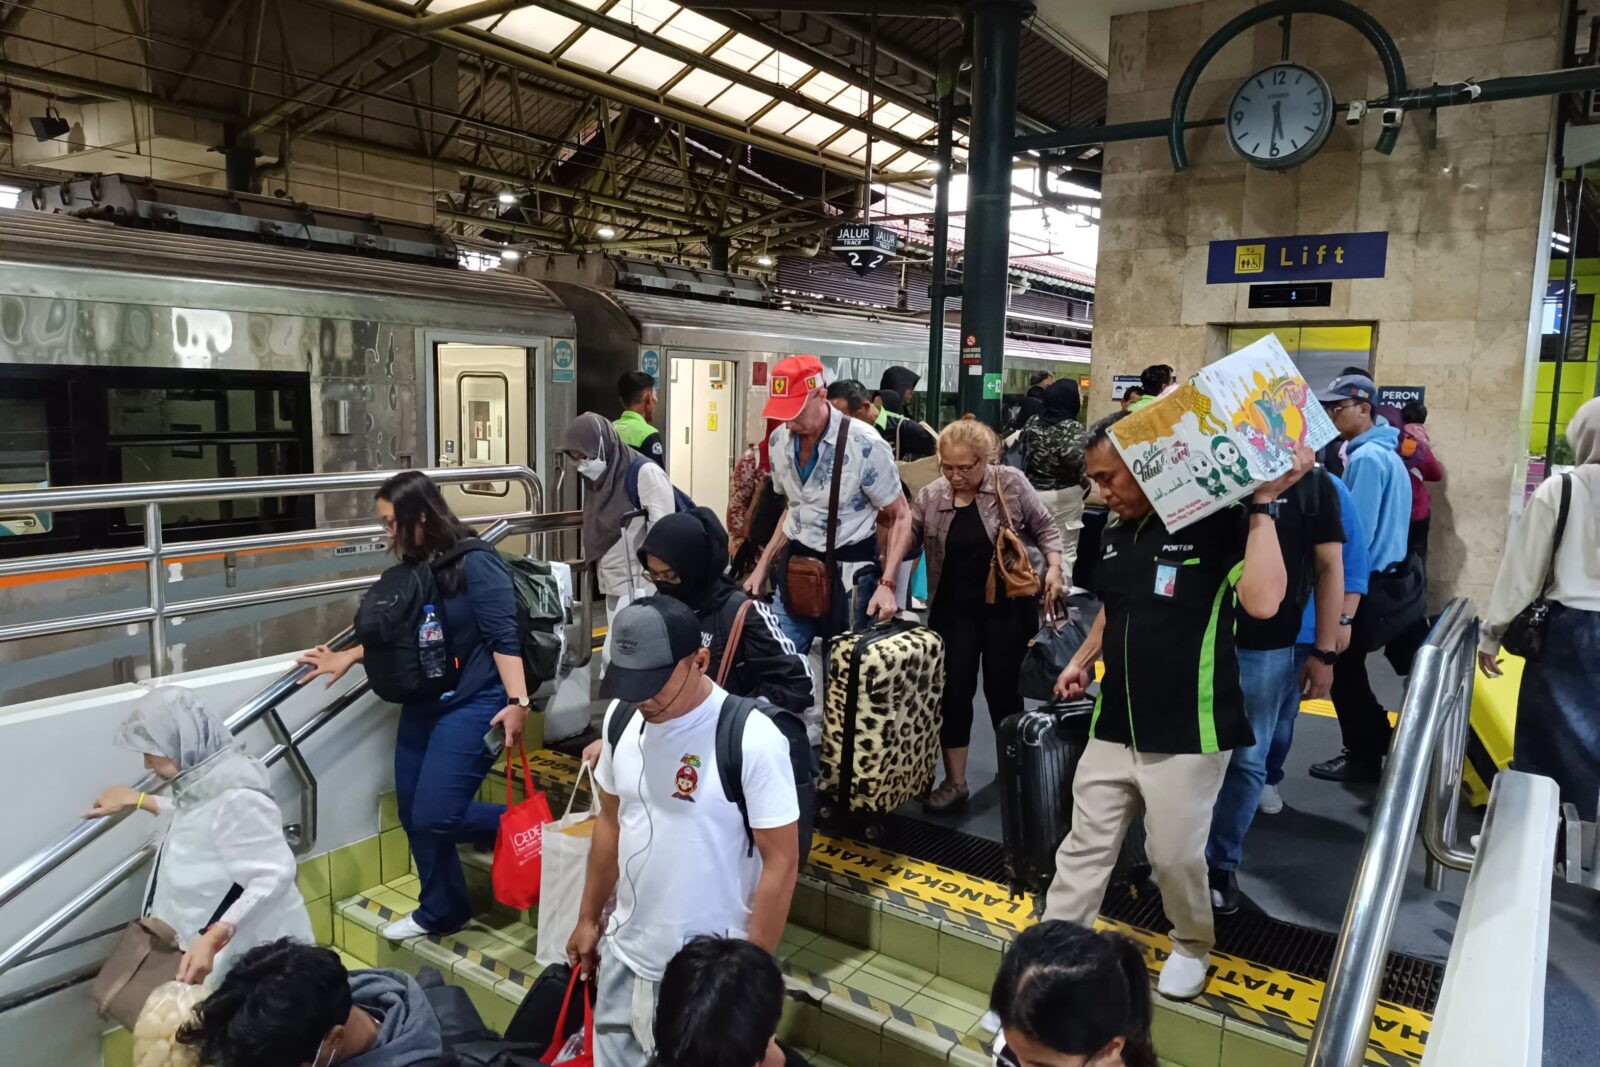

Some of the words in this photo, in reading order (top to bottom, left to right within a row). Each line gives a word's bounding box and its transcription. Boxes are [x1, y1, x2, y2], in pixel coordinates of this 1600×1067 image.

[1272, 70, 1287, 86] 12
[1312, 101, 1322, 117] 3
[1233, 110, 1244, 126] 9
[1269, 142, 1280, 157] 6
[837, 228, 870, 239] JALUR
[876, 230, 895, 245] JALUR
[847, 251, 863, 266] 2
[868, 254, 884, 268] 2
[1280, 245, 1344, 266] Lift
[1290, 291, 1297, 300] 1
[1382, 391, 1420, 400] PERON
[1162, 544, 1194, 552] PORTER
[530, 755, 579, 775] NGGA
[514, 824, 542, 847] CEDE
[812, 842, 876, 868] KAKI
[880, 862, 1022, 914] LANGKAH
[1207, 964, 1296, 1001] HATI
[1374, 1015, 1429, 1044] HA
